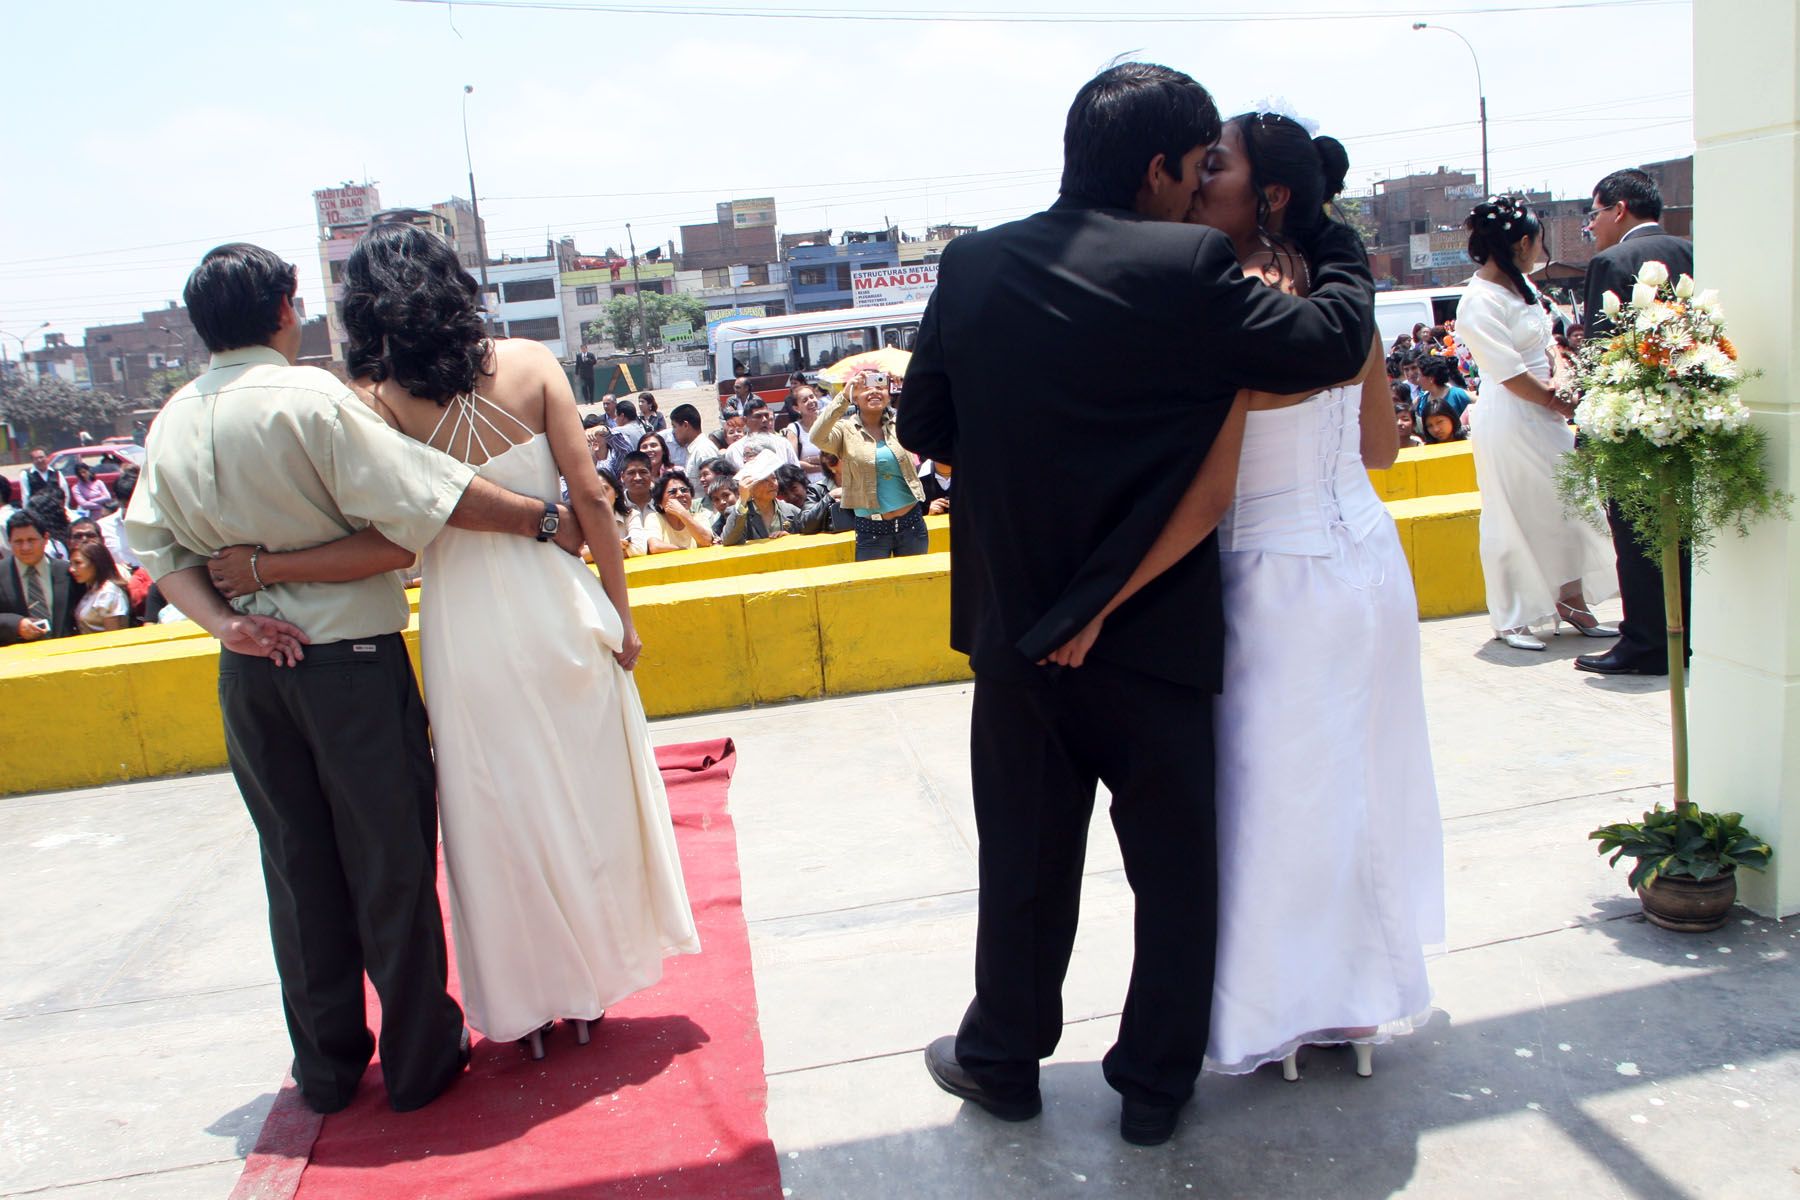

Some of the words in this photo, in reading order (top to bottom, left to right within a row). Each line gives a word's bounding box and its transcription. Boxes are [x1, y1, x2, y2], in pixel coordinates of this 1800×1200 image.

[319, 200, 337, 210] CON
[853, 268, 908, 279] ESTRUCTURAS
[854, 272, 939, 290] MANOL
